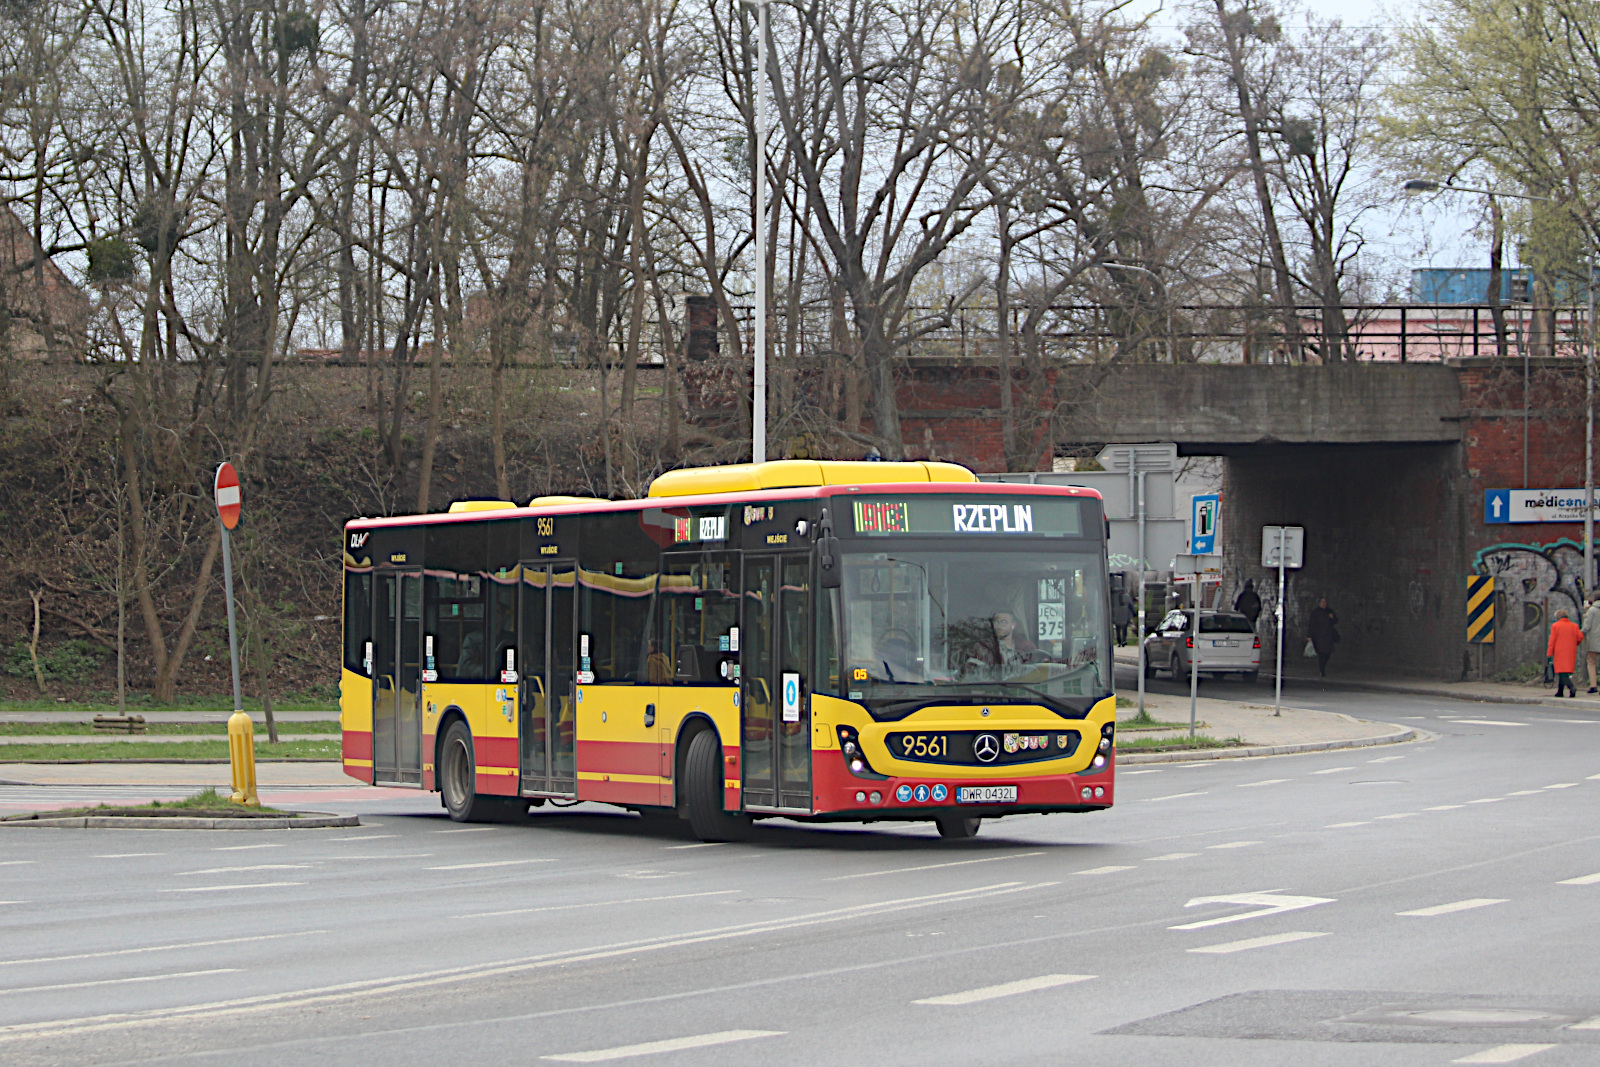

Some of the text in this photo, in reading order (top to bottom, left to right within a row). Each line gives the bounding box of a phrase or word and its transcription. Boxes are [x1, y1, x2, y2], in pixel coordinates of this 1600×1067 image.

[1525, 496, 1600, 509] medicone
[537, 517, 554, 536] 9561
[952, 504, 1033, 532] RZEPLIN
[699, 516, 725, 540] RZEPLIN
[853, 668, 868, 681] 05
[902, 735, 947, 757] 9561
[962, 788, 1015, 800] DWR 0432L
